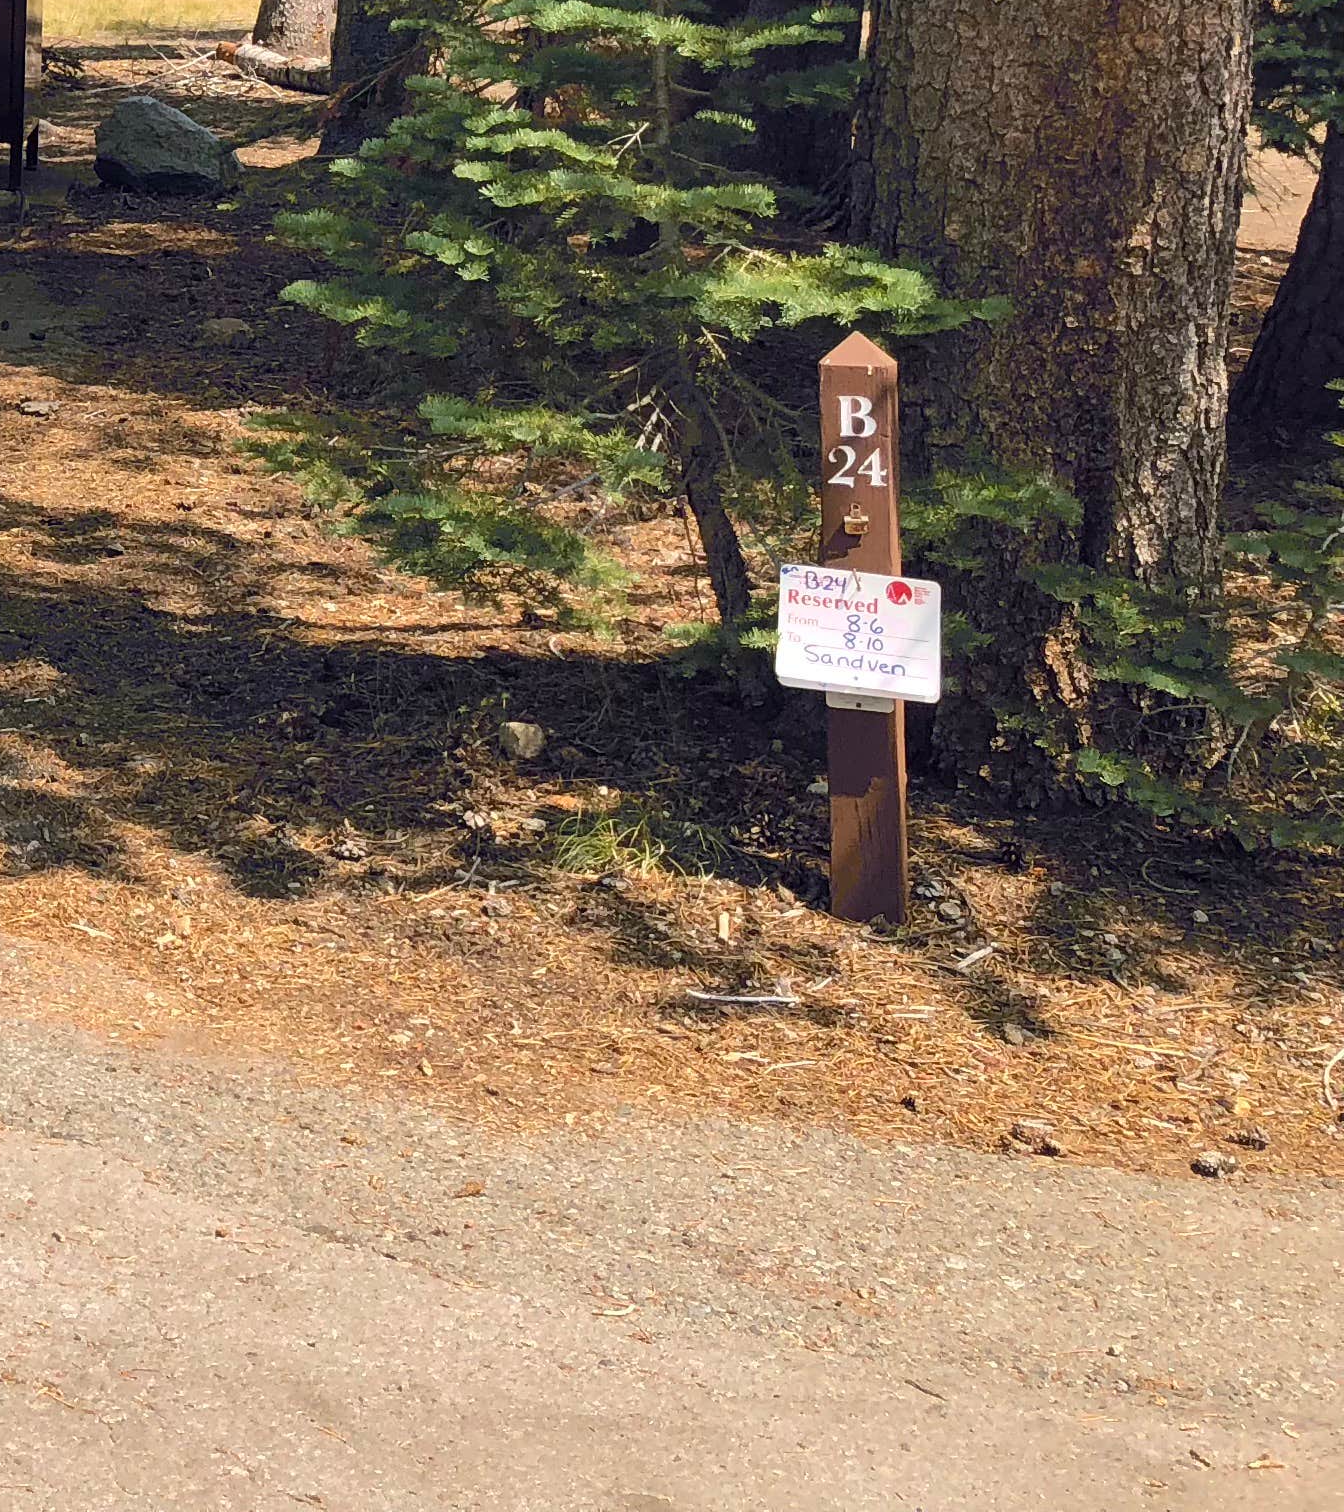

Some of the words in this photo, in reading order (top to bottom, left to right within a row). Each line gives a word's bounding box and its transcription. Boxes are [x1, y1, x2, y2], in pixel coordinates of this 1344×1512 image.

[836, 395, 877, 438] B
[827, 445, 888, 488] 24
[805, 570, 847, 594] B24
[787, 589, 879, 614] Reserved
[787, 613, 819, 627] From
[787, 631, 801, 643] To
